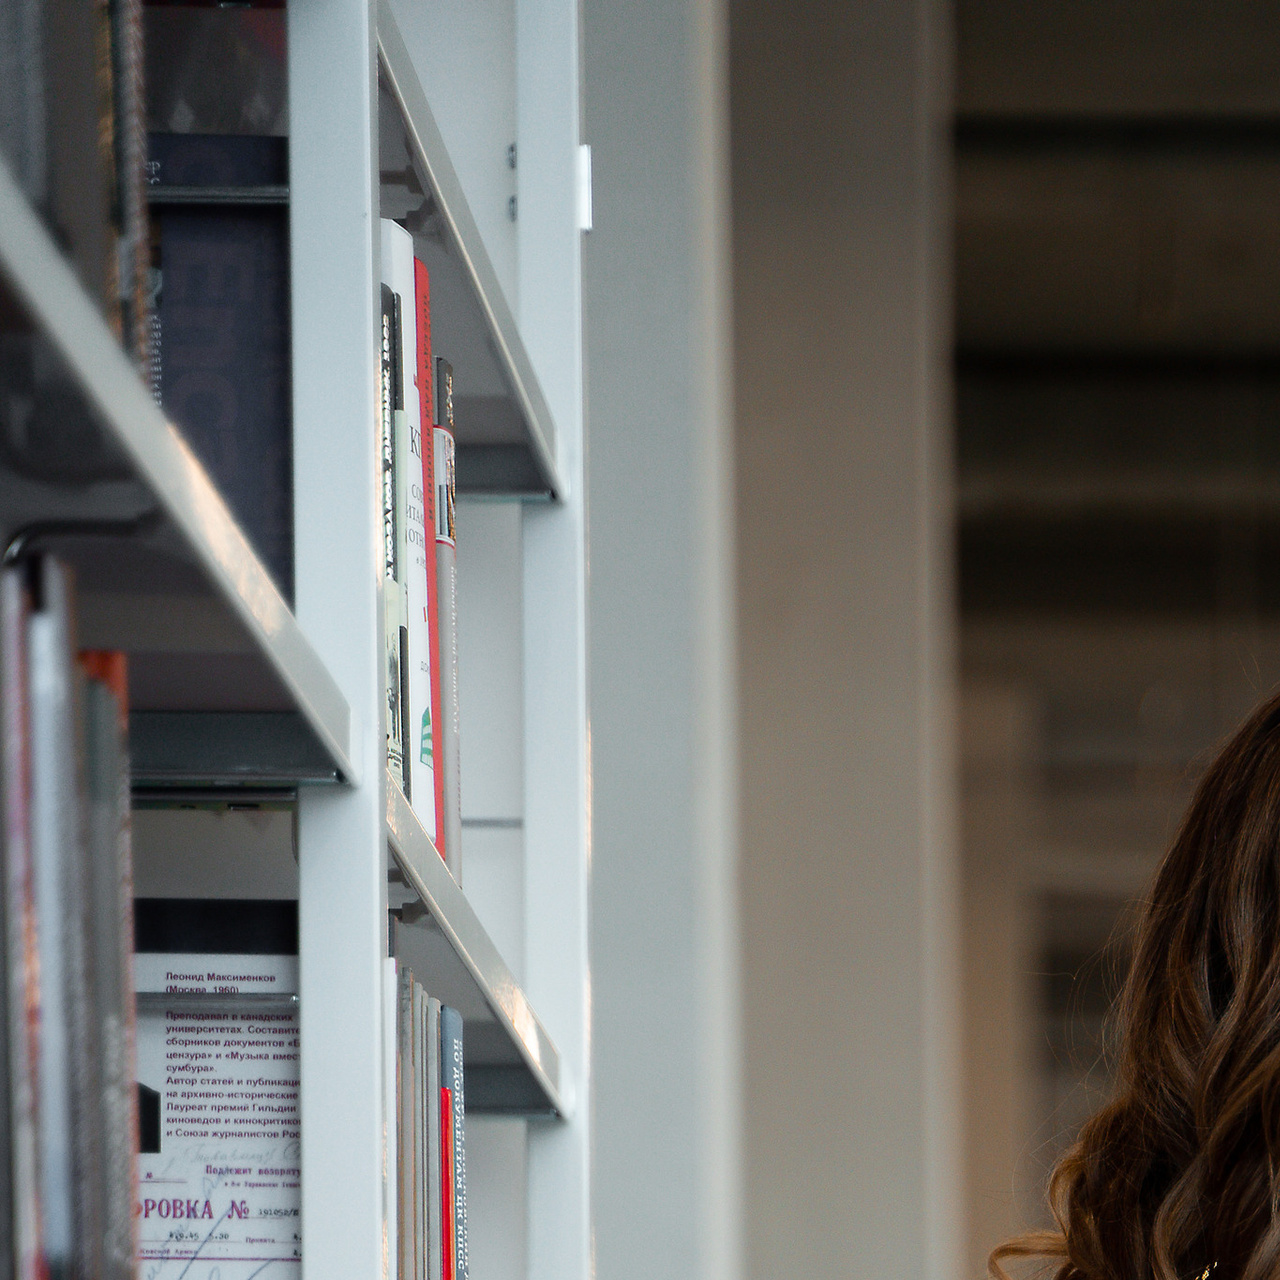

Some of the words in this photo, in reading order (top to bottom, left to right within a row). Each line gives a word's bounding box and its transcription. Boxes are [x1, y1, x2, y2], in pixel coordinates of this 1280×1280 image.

[165, 972, 204, 983] Леонид
[207, 972, 276, 983] Максименков
[165, 1011, 229, 1022] Преподавал
[241, 1011, 293, 1022] канадских
[165, 1025, 243, 1036] университетах.
[165, 1037, 221, 1048] сборников
[224, 1037, 285, 1048] документов
[165, 1051, 212, 1062] цензура»
[225, 1051, 270, 1062] «Музыка
[166, 1077, 197, 1088] Автор
[200, 1077, 234, 1088] статей
[166, 1090, 178, 1100] на
[181, 1090, 298, 1100] архивно-исторические
[166, 1103, 207, 1113] Лауреат
[211, 1103, 249, 1113] премий
[252, 1103, 297, 1113] Гильдии
[166, 1116, 221, 1126] киноведов
[175, 1130, 209, 1140] Союза
[212, 1130, 279, 1140] журналистов
[205, 1165, 252, 1176] Подлежит
